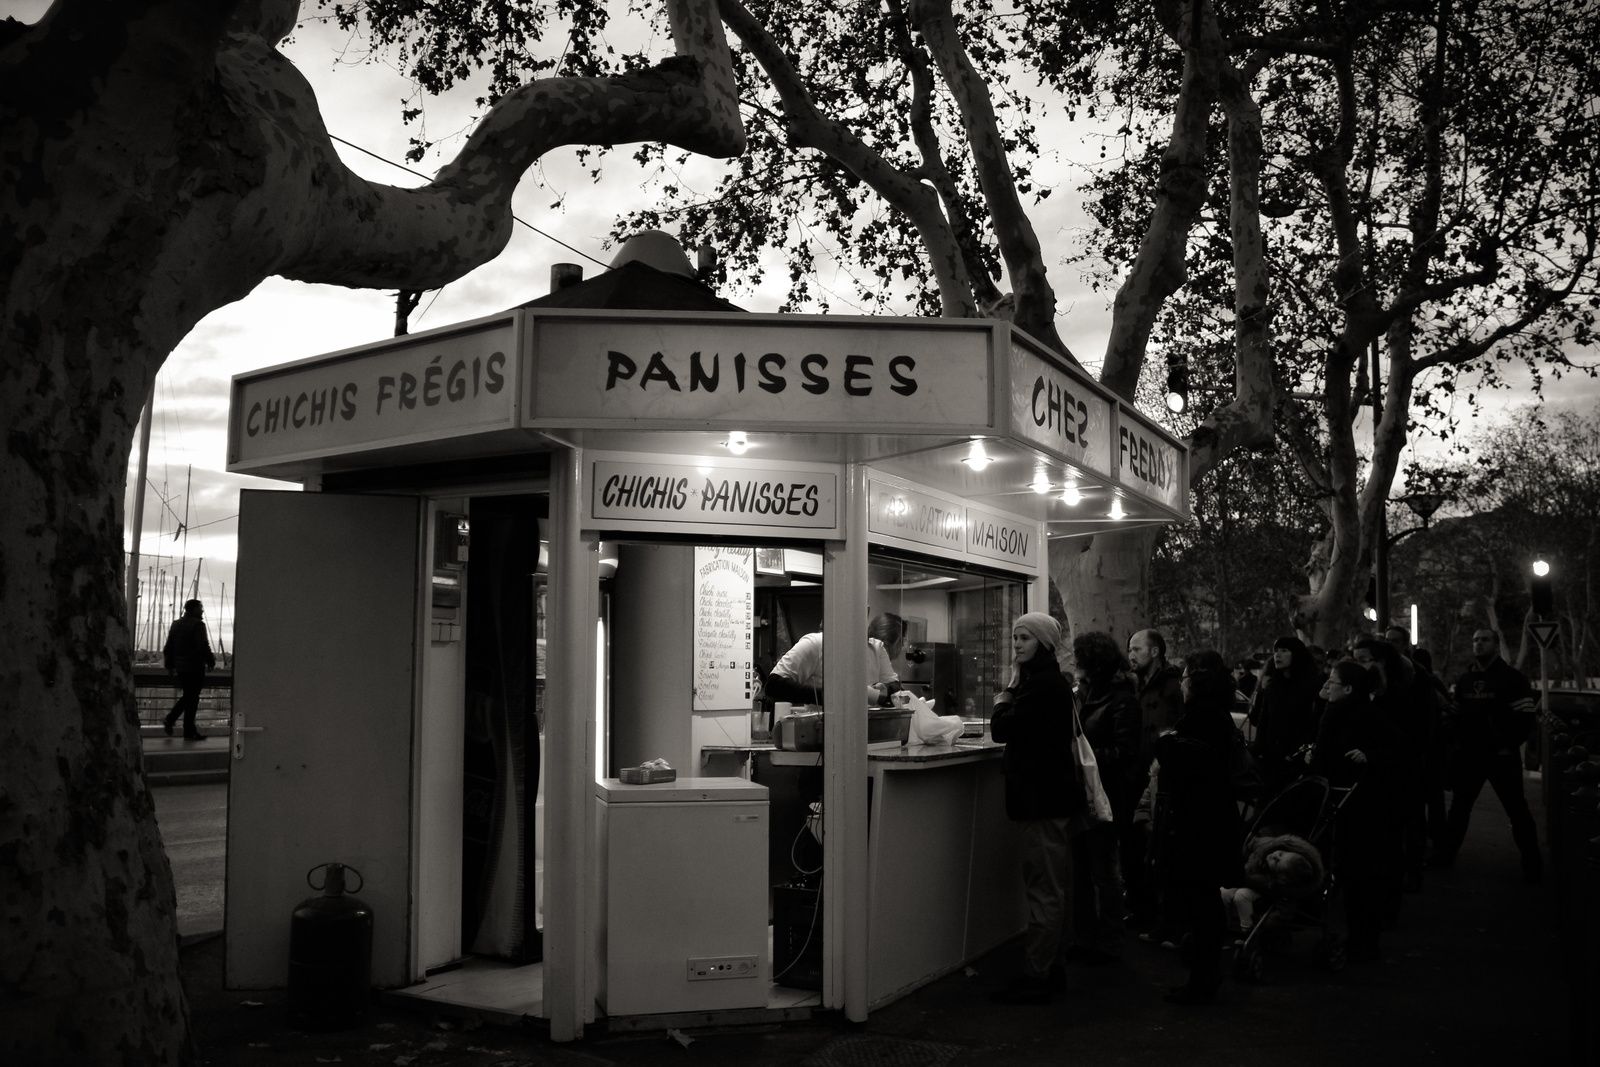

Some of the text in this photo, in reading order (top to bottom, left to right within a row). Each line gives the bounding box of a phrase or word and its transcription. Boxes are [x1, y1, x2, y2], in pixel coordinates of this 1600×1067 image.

[246, 351, 506, 438] CHICHIS FRÉGIS
[605, 350, 919, 397] PANISSES
[1031, 375, 1173, 491] CHEZ FREDDY
[602, 473, 819, 517] CHICHIS PANISSES
[972, 519, 1029, 558] MAISON
